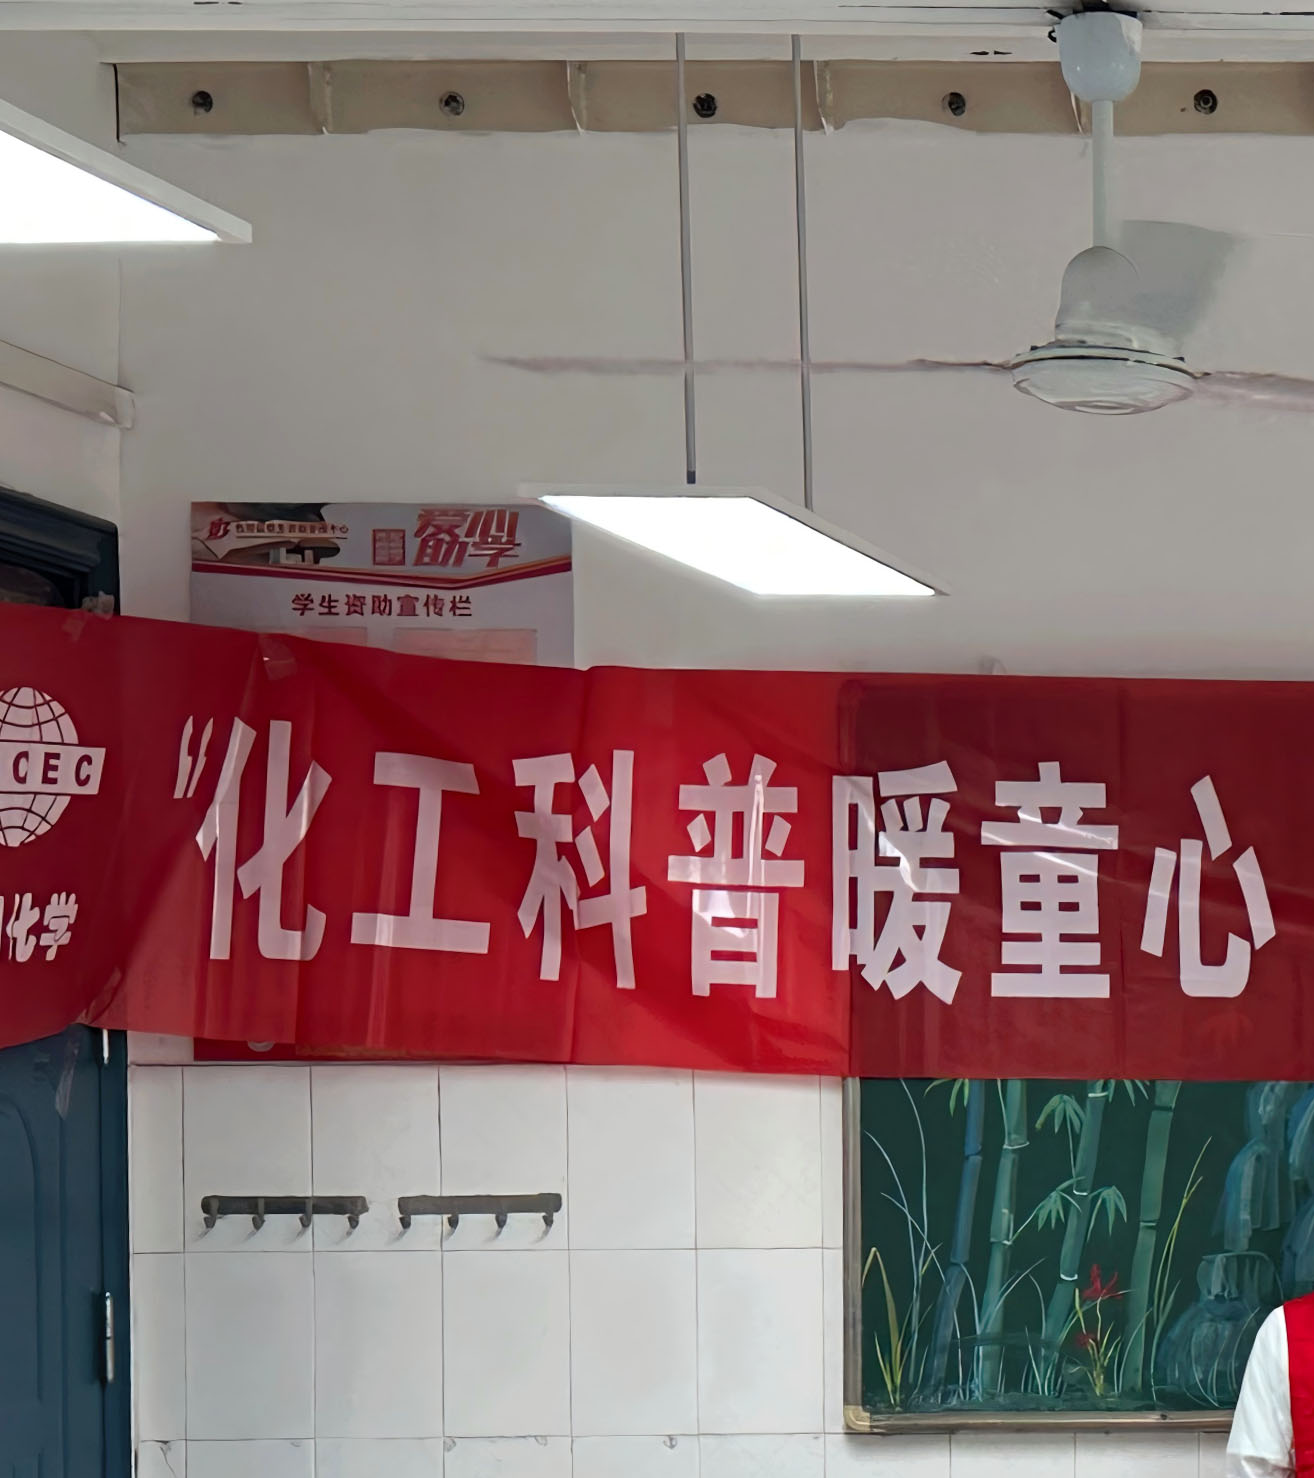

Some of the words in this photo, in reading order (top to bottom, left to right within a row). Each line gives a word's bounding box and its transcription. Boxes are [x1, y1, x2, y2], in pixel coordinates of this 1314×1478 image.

[291, 593, 473, 617] 学生资助宣传栏
[0, 891, 79, 964] 化学
